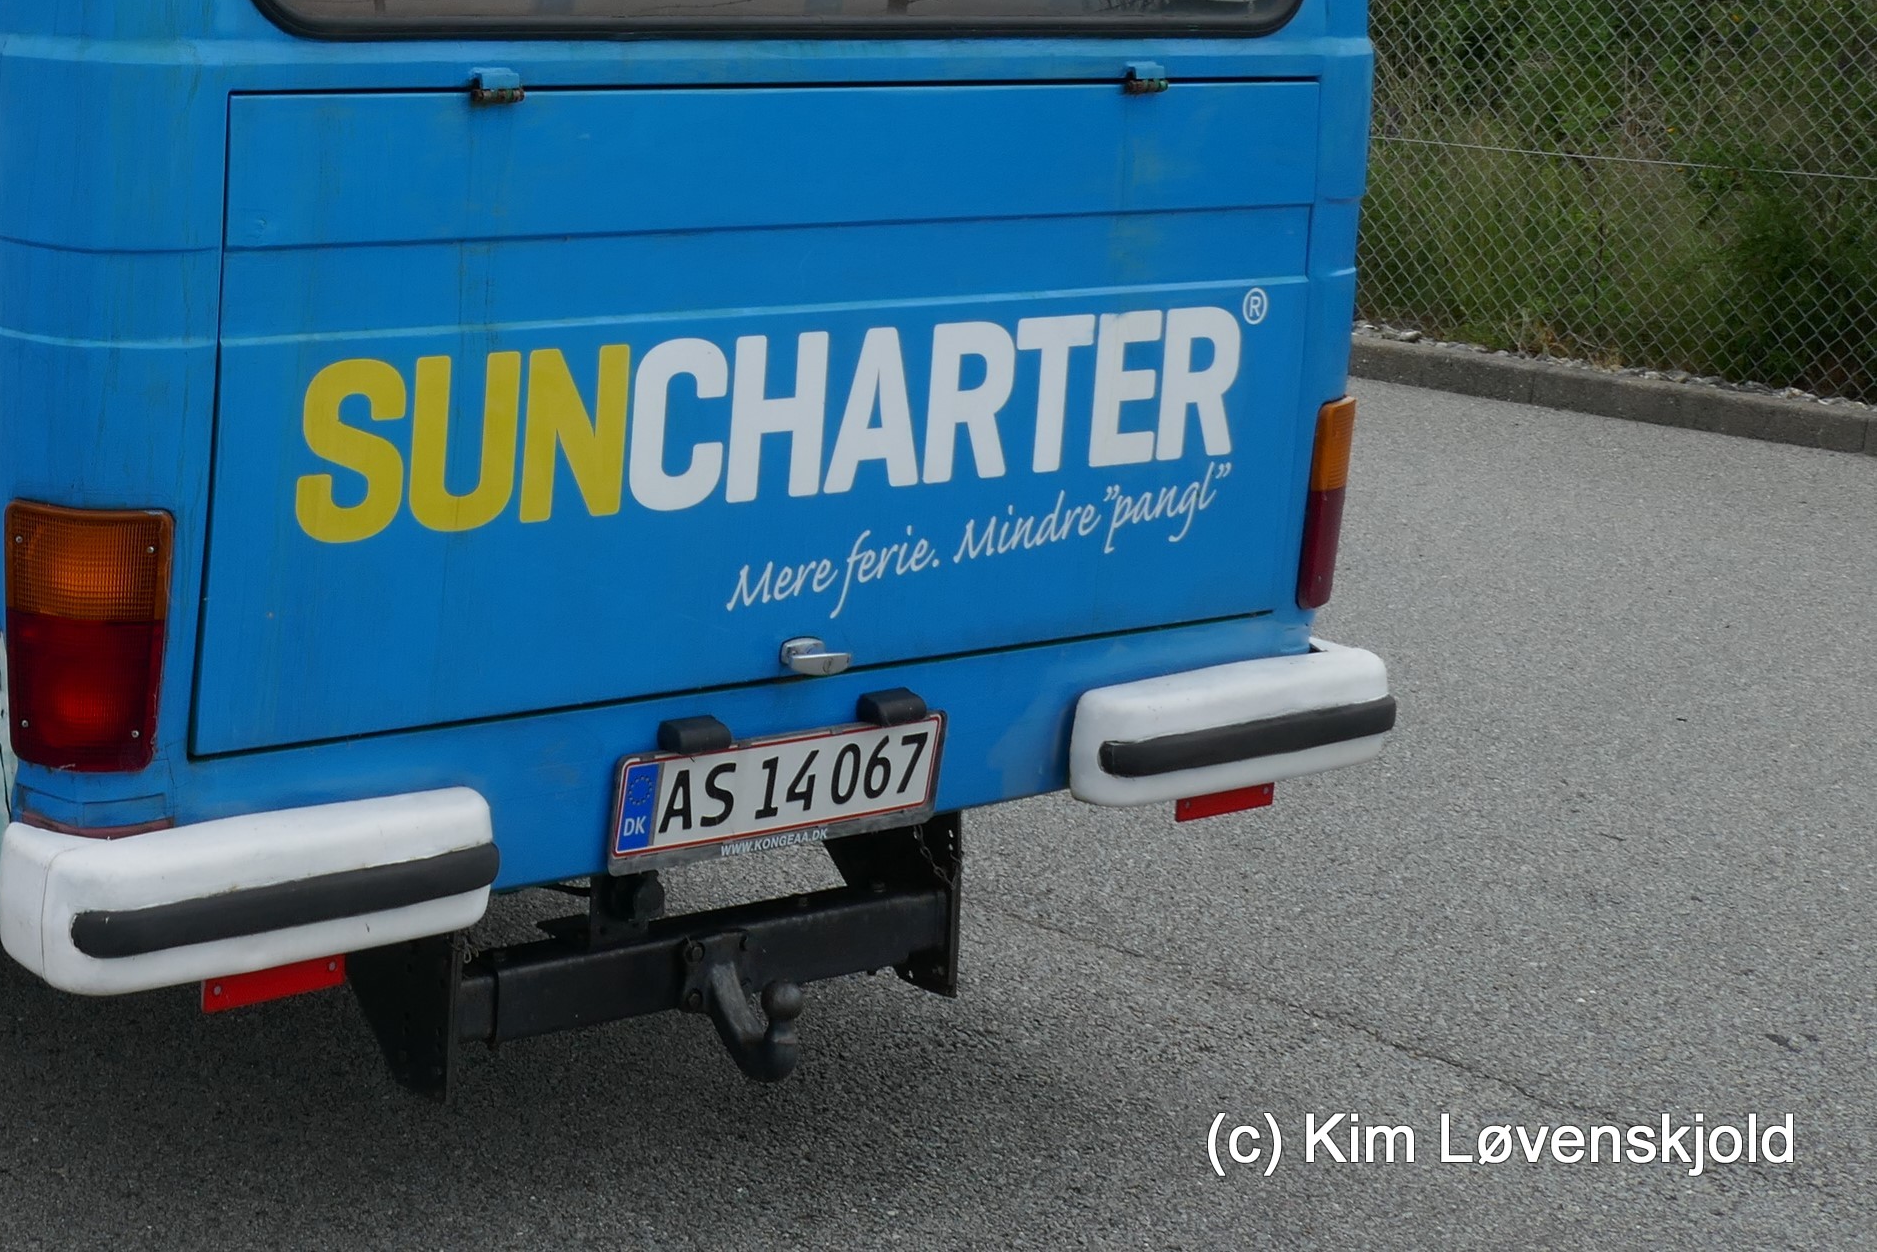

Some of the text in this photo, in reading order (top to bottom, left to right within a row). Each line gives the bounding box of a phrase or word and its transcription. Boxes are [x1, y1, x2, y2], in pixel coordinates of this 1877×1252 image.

[726, 560, 839, 612] Mere
[830, 524, 941, 619] ferie.
[953, 489, 1101, 564] Mindre
[658, 762, 737, 834] AS
[623, 816, 646, 838] DK
[720, 827, 829, 857] WWW.KONGEAA.DK
